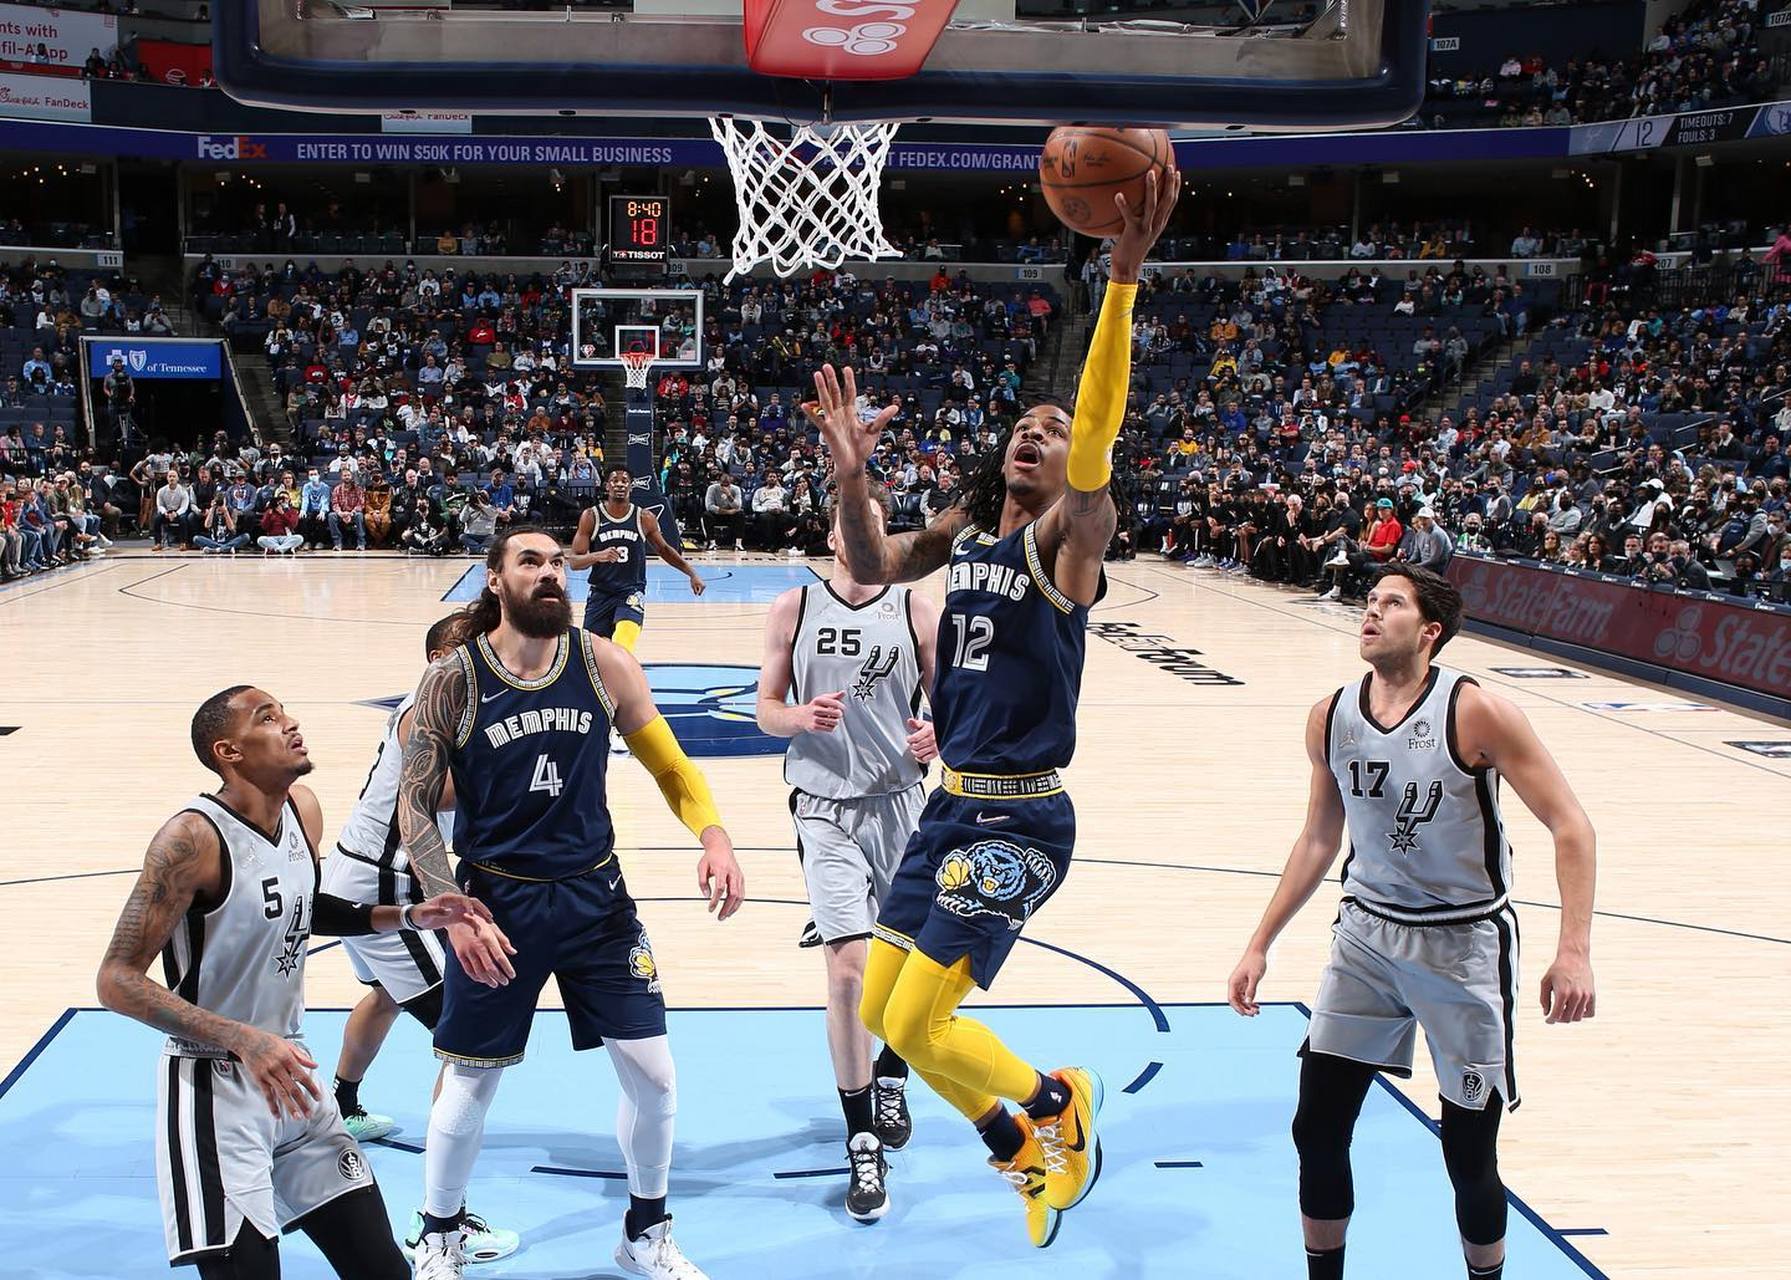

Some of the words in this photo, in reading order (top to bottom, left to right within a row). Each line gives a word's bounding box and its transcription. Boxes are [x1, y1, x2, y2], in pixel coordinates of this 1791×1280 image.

[25, 24, 57, 38] with
[45, 97, 88, 110] FanDeck
[1680, 113, 1726, 130] TIMEOUTS:
[1727, 112, 1734, 125] 7
[1636, 121, 1653, 147] 12
[1677, 130, 1706, 144] FOULS:
[1708, 129, 1716, 141] 3
[198, 136, 268, 160] FedEx
[297, 143, 348, 160] ENTER
[349, 144, 372, 160] TO
[377, 144, 410, 160] WIN
[414, 144, 449, 161] $50K
[454, 145, 483, 161] FOR
[487, 145, 530, 162] YOUR
[535, 146, 588, 163] SMALL
[592, 147, 672, 164] BUSINESS
[627, 201, 661, 217] 8:40
[633, 218, 656, 245] 18
[628, 250, 665, 260] TISSOT
[147, 363, 158, 373] of
[158, 363, 207, 374] Tennessee
[598, 529, 639, 543] MEMPHIS
[816, 627, 862, 657] 25
[952, 613, 995, 672] 12
[484, 707, 593, 750] MEMPHIS
[1408, 738, 1437, 750] Frost
[528, 753, 564, 798] 4
[1348, 760, 1391, 798] 17
[261, 876, 284, 920] 5
